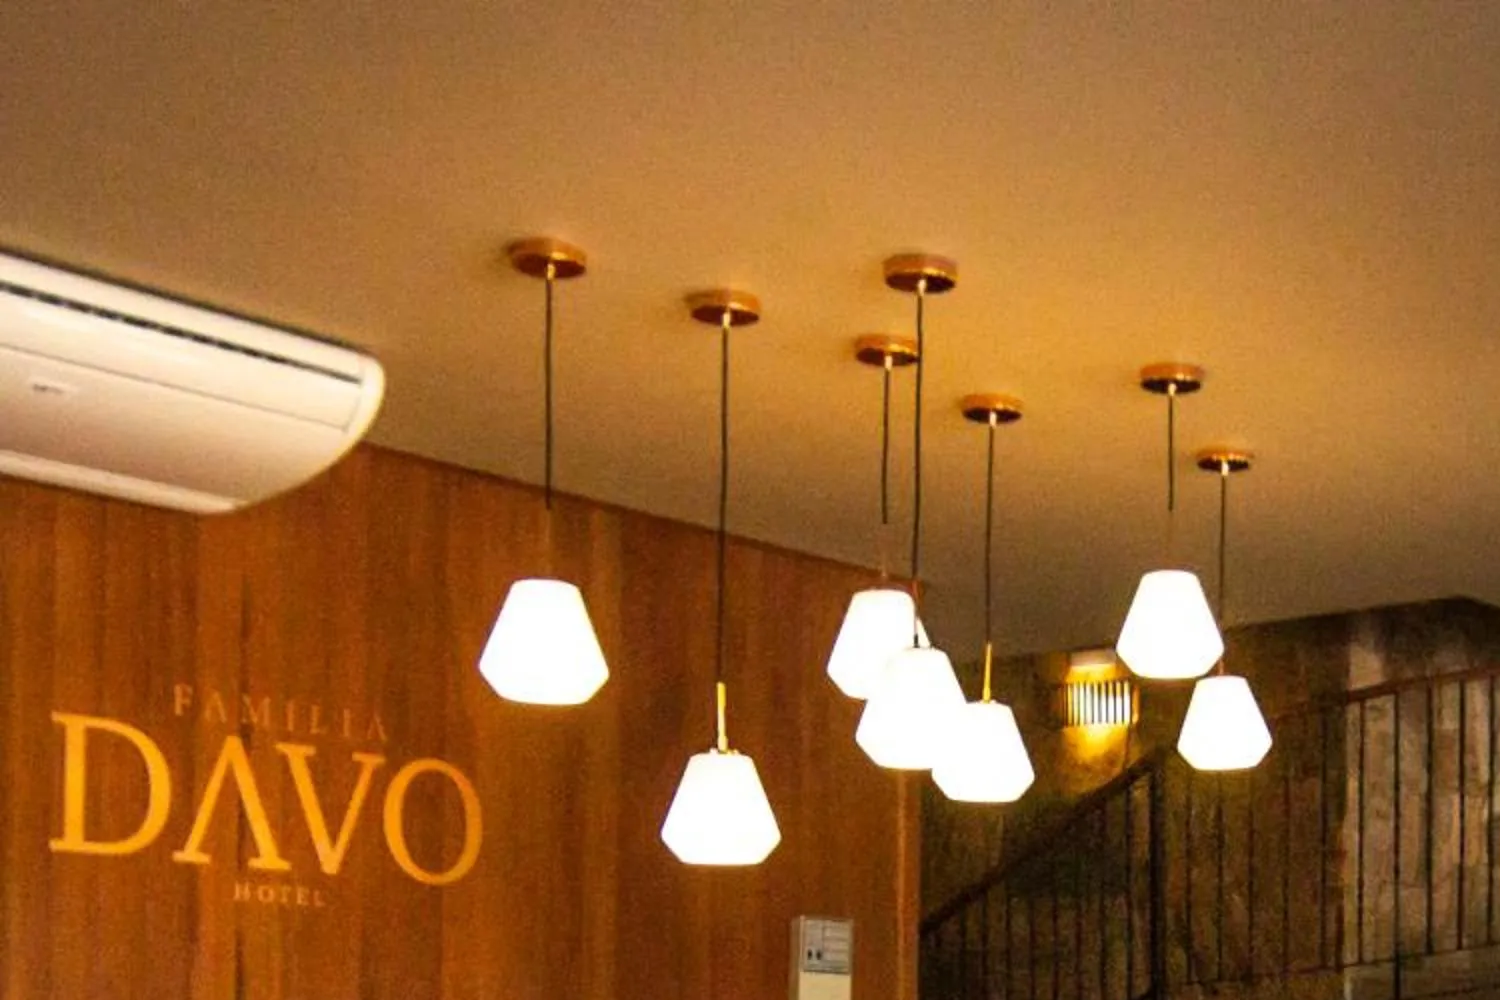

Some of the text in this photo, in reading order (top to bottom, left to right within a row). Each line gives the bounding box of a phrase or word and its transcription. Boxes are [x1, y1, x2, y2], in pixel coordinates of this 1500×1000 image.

[173, 682, 388, 741] FAMILIA
[49, 711, 483, 886] DAVO
[232, 881, 326, 908] HOTEL
